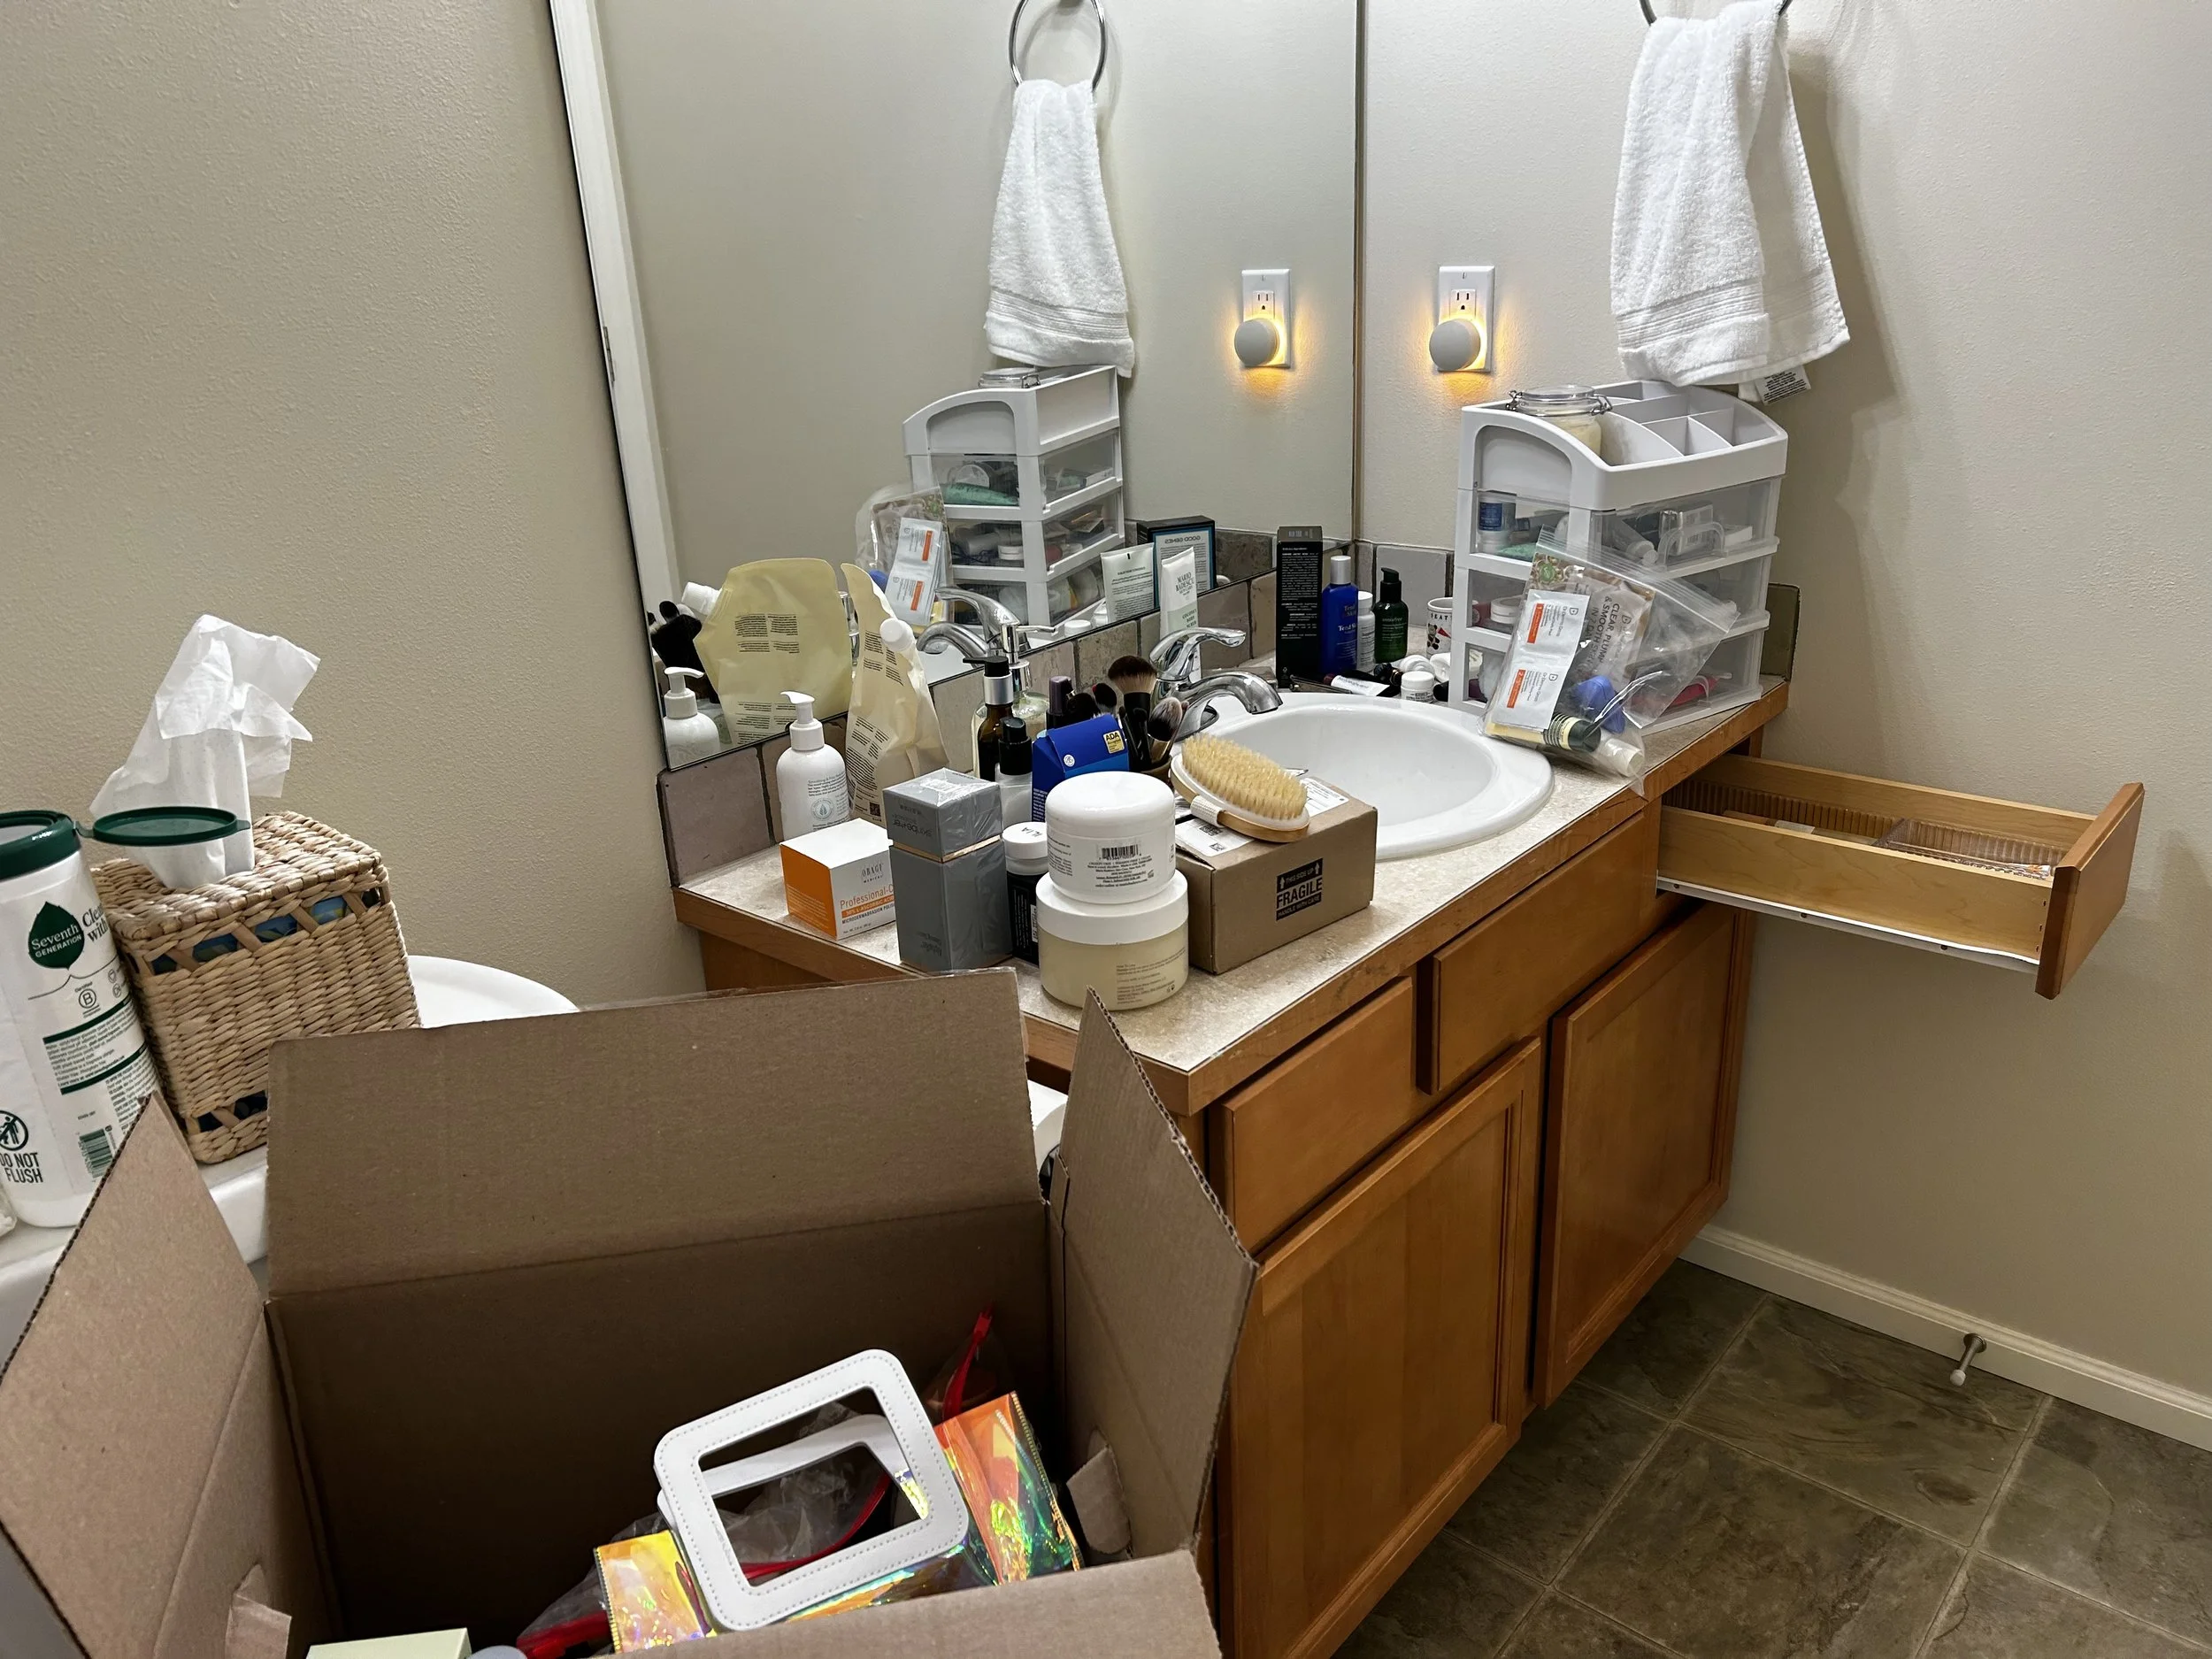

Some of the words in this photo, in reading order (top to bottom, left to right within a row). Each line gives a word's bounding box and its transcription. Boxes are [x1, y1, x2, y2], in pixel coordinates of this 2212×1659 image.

[1177, 572, 1192, 582] MARIO
[1594, 604, 1610, 642] SMOOTH
[862, 864, 882, 877] OBAGI
[1286, 874, 1295, 884] THIS
[1296, 871, 1307, 879] SIDE
[1277, 877, 1323, 909] FRAGILE
[1278, 905, 1295, 918] HANDLE
[1296, 901, 1307, 910] WITH
[1307, 895, 1320, 904] CARE
[842, 907, 883, 924] MICRODERMABRASION
[31, 924, 80, 950] Seventh
[35, 934, 82, 958] GENERATION
[13, 1152, 39, 1168] NOT
[4, 1168, 43, 1183] FLUSH
